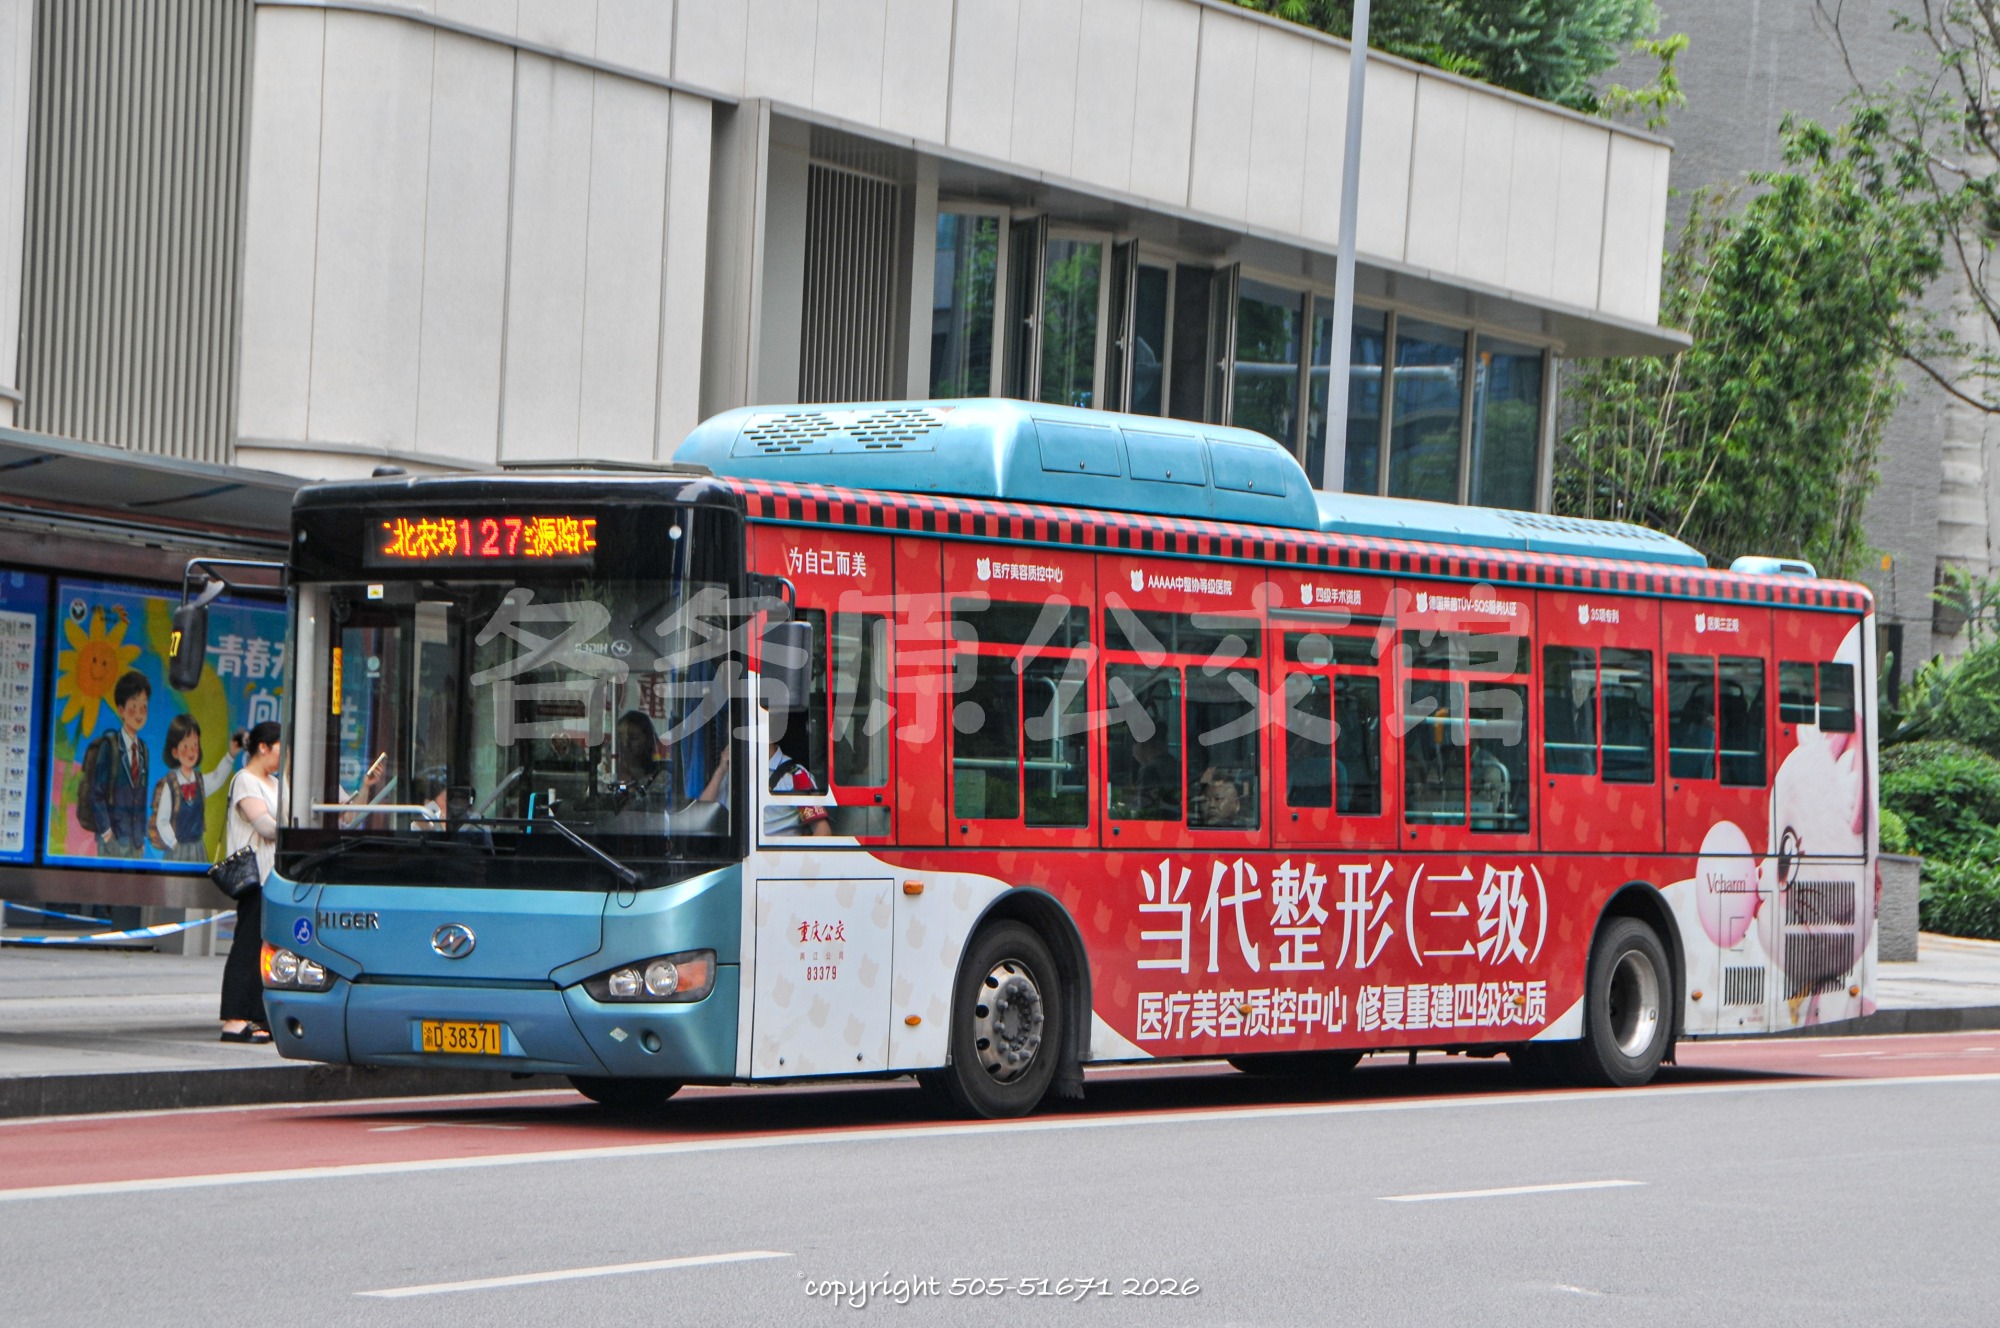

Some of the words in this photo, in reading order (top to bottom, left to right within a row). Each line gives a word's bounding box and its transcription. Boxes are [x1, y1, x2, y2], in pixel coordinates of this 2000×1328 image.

[460, 518, 522, 556] 127
[992, 561, 1063, 583] 医疗美容质控中心
[1315, 587, 1361, 606] 四级手术资质
[317, 911, 380, 931] HIGER
[798, 920, 846, 943] 重庆公交
[806, 965, 837, 981] 83379
[1136, 984, 1349, 1041] 医疗美容质控中心
[1355, 979, 1547, 1033] 修复重建四级资质
